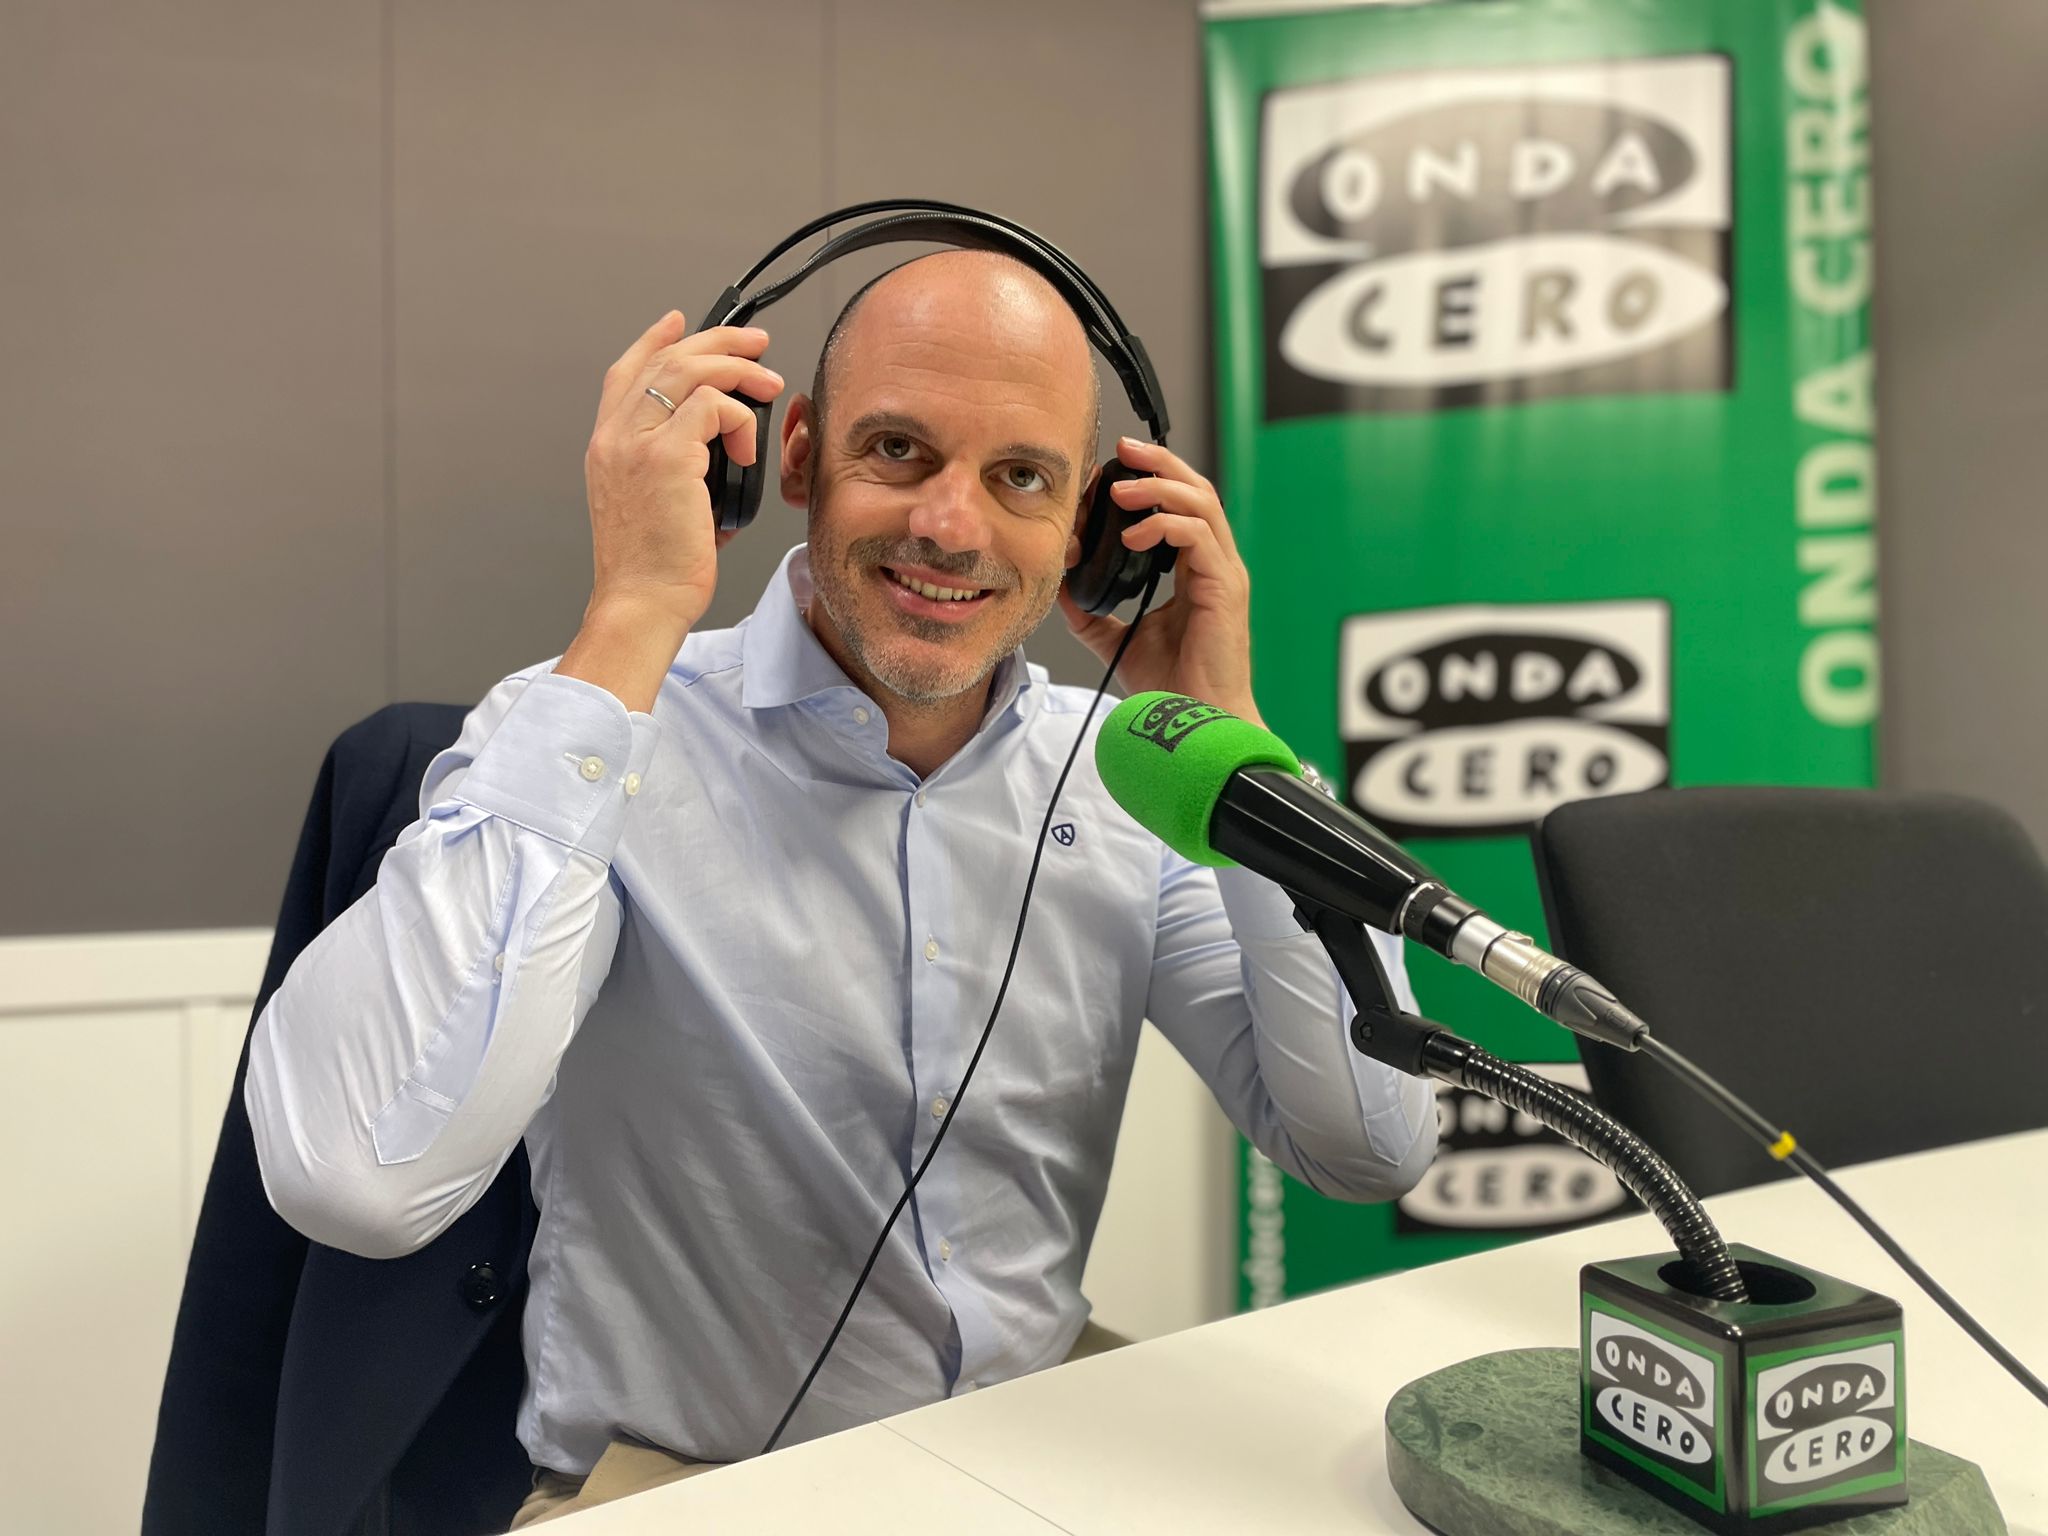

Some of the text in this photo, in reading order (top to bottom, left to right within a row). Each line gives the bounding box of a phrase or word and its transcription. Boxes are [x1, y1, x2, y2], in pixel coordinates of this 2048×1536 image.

[1322, 131, 1663, 220] ONDA
[1342, 267, 1665, 356] CERO
[1783, 5, 1880, 728] ONDA CERO
[1379, 649, 1624, 714] ONDA
[1402, 746, 1617, 798] CERO
[1434, 1165, 1595, 1207] CERO
[1605, 1340, 1695, 1403] ONDA
[1775, 1374, 1876, 1419] ONDA
[1610, 1393, 1696, 1456] CERO
[1782, 1427, 1876, 1473] CERO
